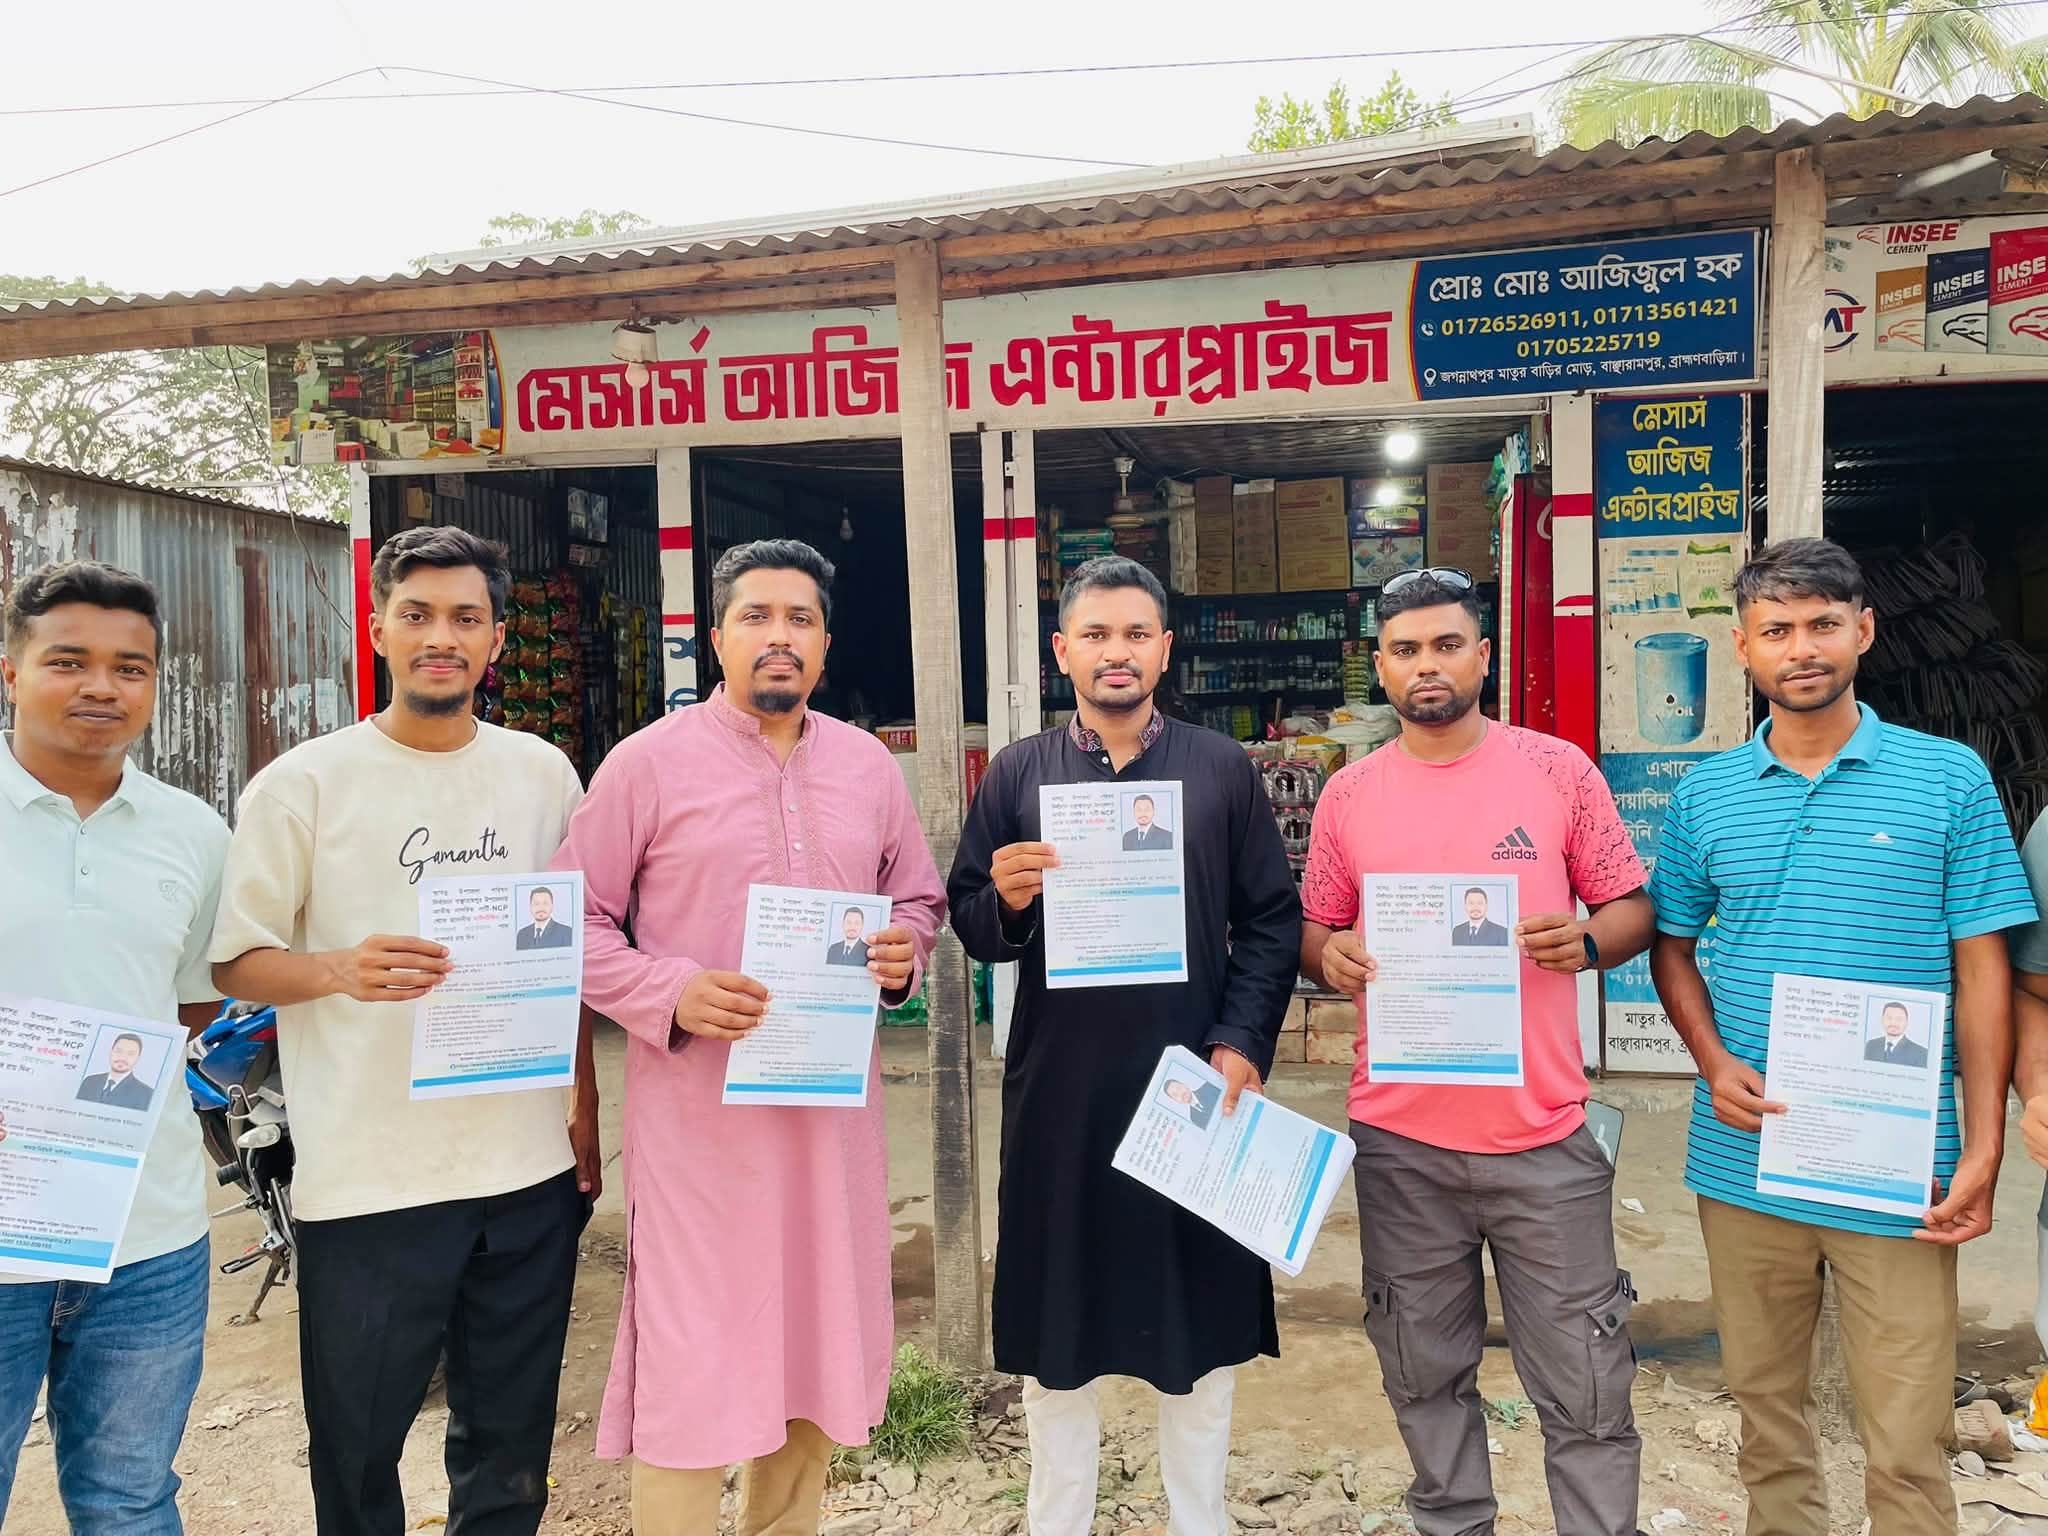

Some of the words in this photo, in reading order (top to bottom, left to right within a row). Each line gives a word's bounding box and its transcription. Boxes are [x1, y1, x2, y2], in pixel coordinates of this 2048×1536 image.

[1886, 222, 1961, 244] INSEE
[1886, 244, 1928, 255] CEMENT
[1429, 274, 1483, 302] প্রোঃ
[1493, 268, 1550, 297] মোঃ
[1559, 253, 1687, 294] আজিজুল
[1694, 252, 1744, 283] হক
[1933, 269, 1985, 296] INSEE
[1997, 256, 2047, 284] INSE
[1880, 284, 1923, 306] INSEE
[1441, 309, 1589, 336] 01726526911,
[1593, 297, 1739, 326] 01713561421
[1517, 330, 1661, 358] 01705225719
[517, 325, 711, 432] মেসার্স
[990, 299, 1392, 417] এন্টারপ্রাইজ
[1626, 436, 1713, 476] আজিজ
[1602, 483, 1740, 522] এন্টারপ্রাইজ
[398, 826, 509, 885] Samantha
[1491, 847, 1538, 861] adidas
[1624, 1013, 1656, 1029] মাতুর
